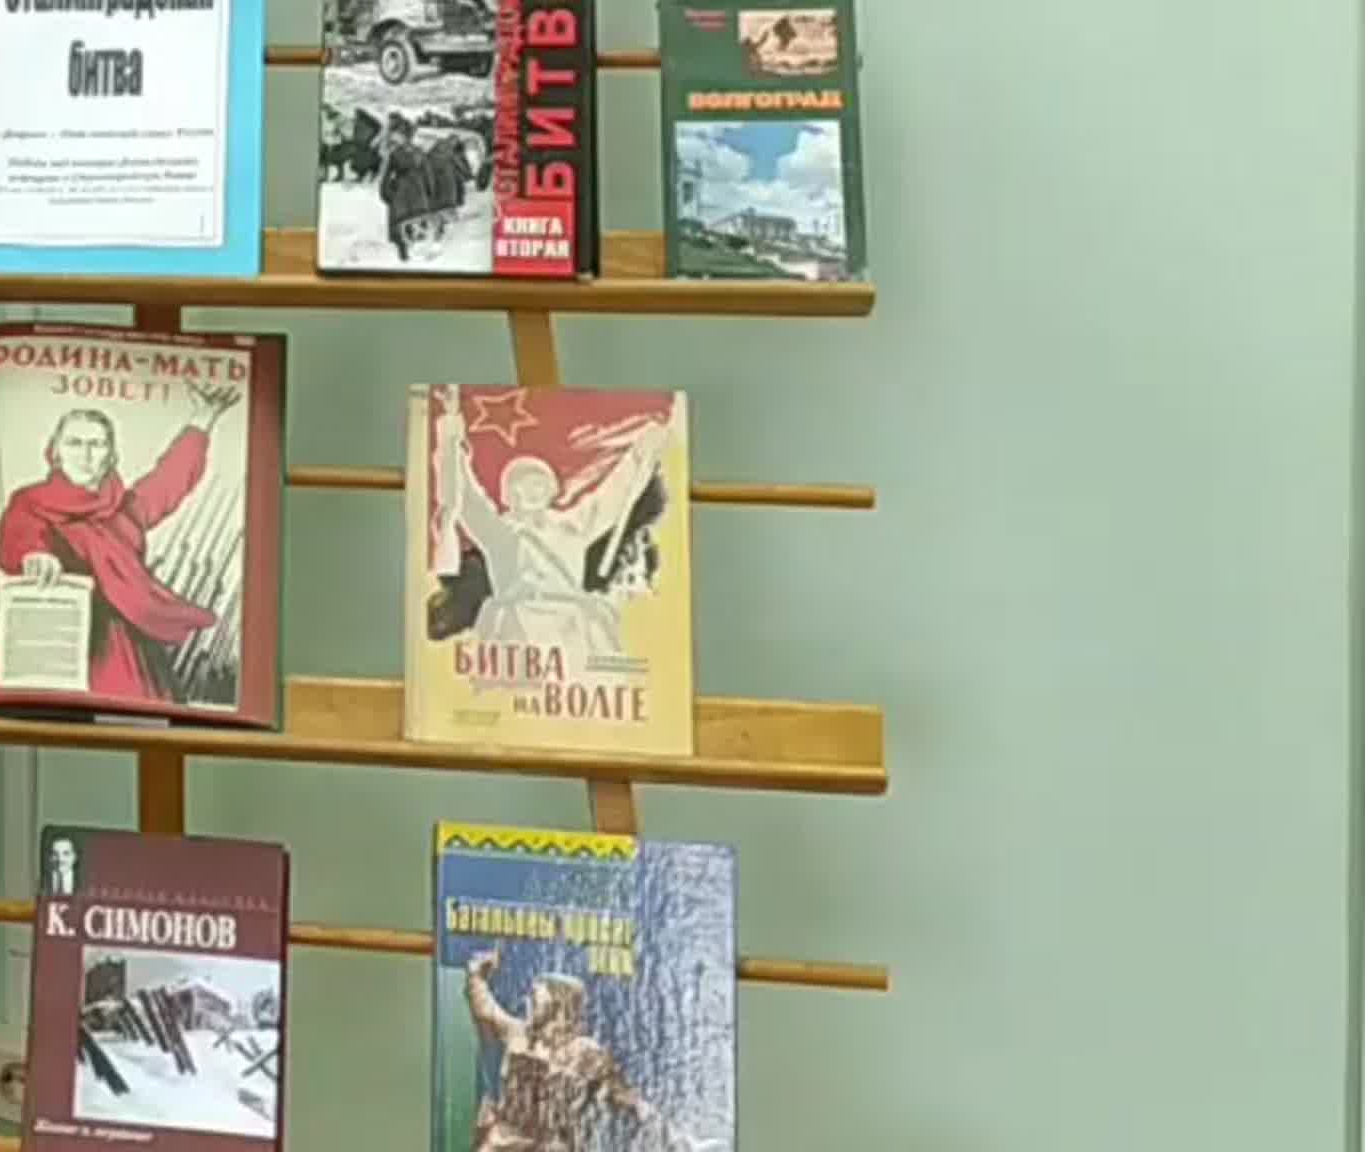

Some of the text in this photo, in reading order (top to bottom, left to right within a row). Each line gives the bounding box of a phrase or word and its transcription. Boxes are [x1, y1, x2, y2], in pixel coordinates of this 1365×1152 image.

[67, 39, 144, 98] битва
[688, 90, 844, 113] ВОЛГОГРАД
[501, 215, 564, 236] КНИГА
[495, 239, 570, 258] ВТОРАЯ
[51, 373, 171, 404] ЗОВЕТ!
[453, 640, 565, 682] БИТВА
[543, 681, 651, 722] ВОЛГЕ
[45, 900, 238, 950] К. СИМОНОВ
